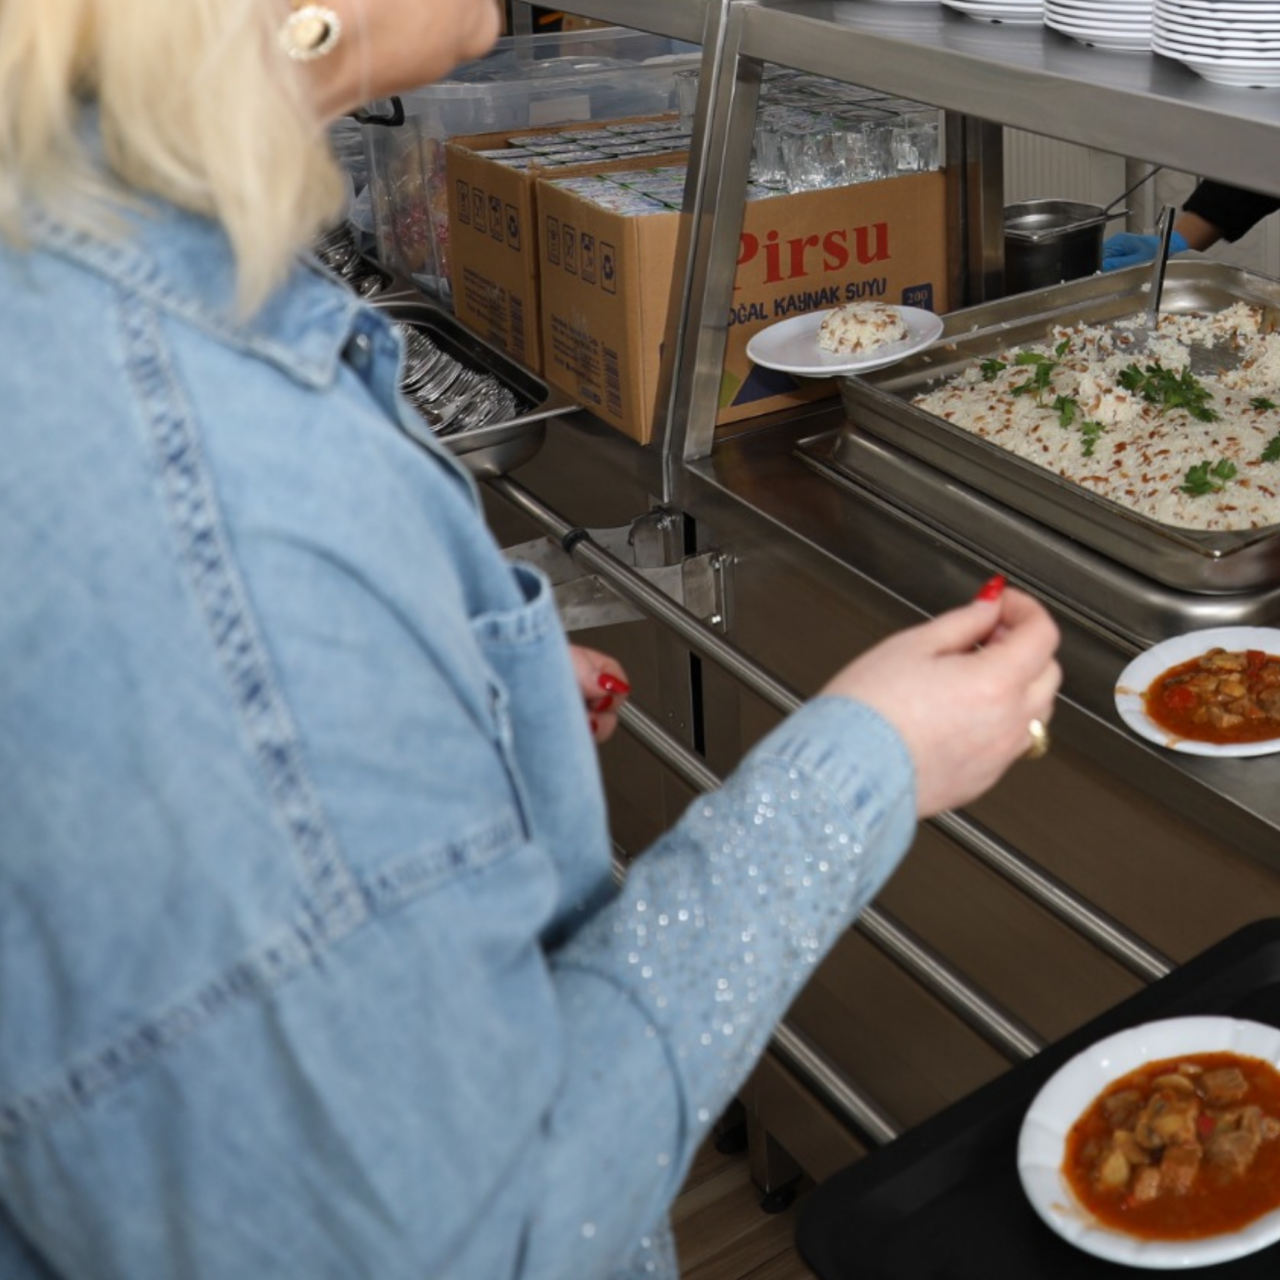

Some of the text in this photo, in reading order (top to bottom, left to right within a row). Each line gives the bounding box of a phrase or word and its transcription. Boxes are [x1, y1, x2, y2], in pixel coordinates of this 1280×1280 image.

[728, 277, 888, 327] OĞAL KAYNAK SUYU
[907, 289, 929, 304] 200
